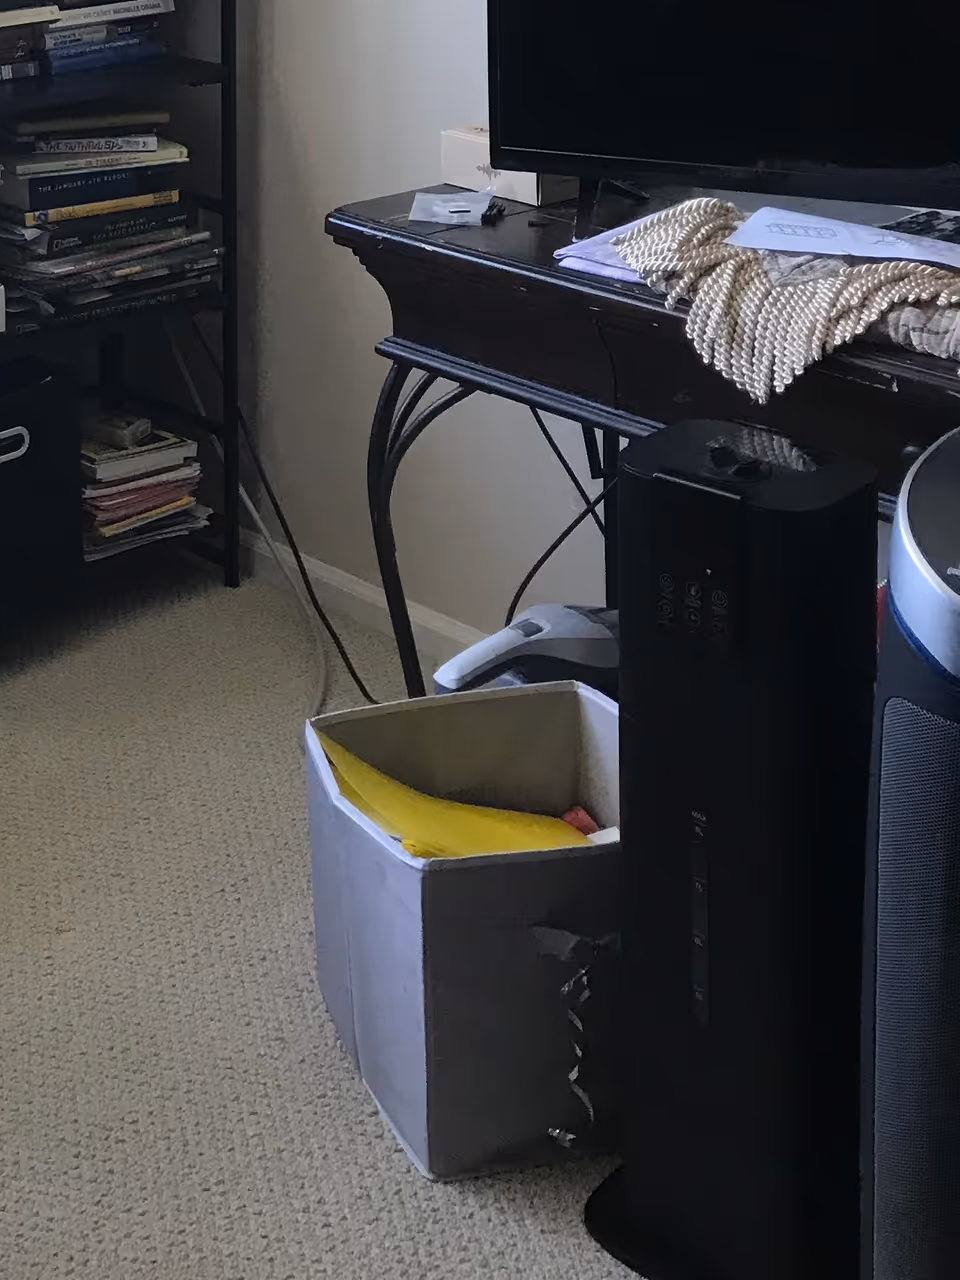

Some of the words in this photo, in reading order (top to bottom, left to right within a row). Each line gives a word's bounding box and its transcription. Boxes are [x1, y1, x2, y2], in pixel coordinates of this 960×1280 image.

[140, 2, 161, 11] OBAMA
[1, 65, 13, 81] BOX
[45, 142, 62, 153] THE
[53, 180, 86, 191] JANUARY
[103, 173, 130, 182] REPORT
[691, 809, 707, 822] MAX
